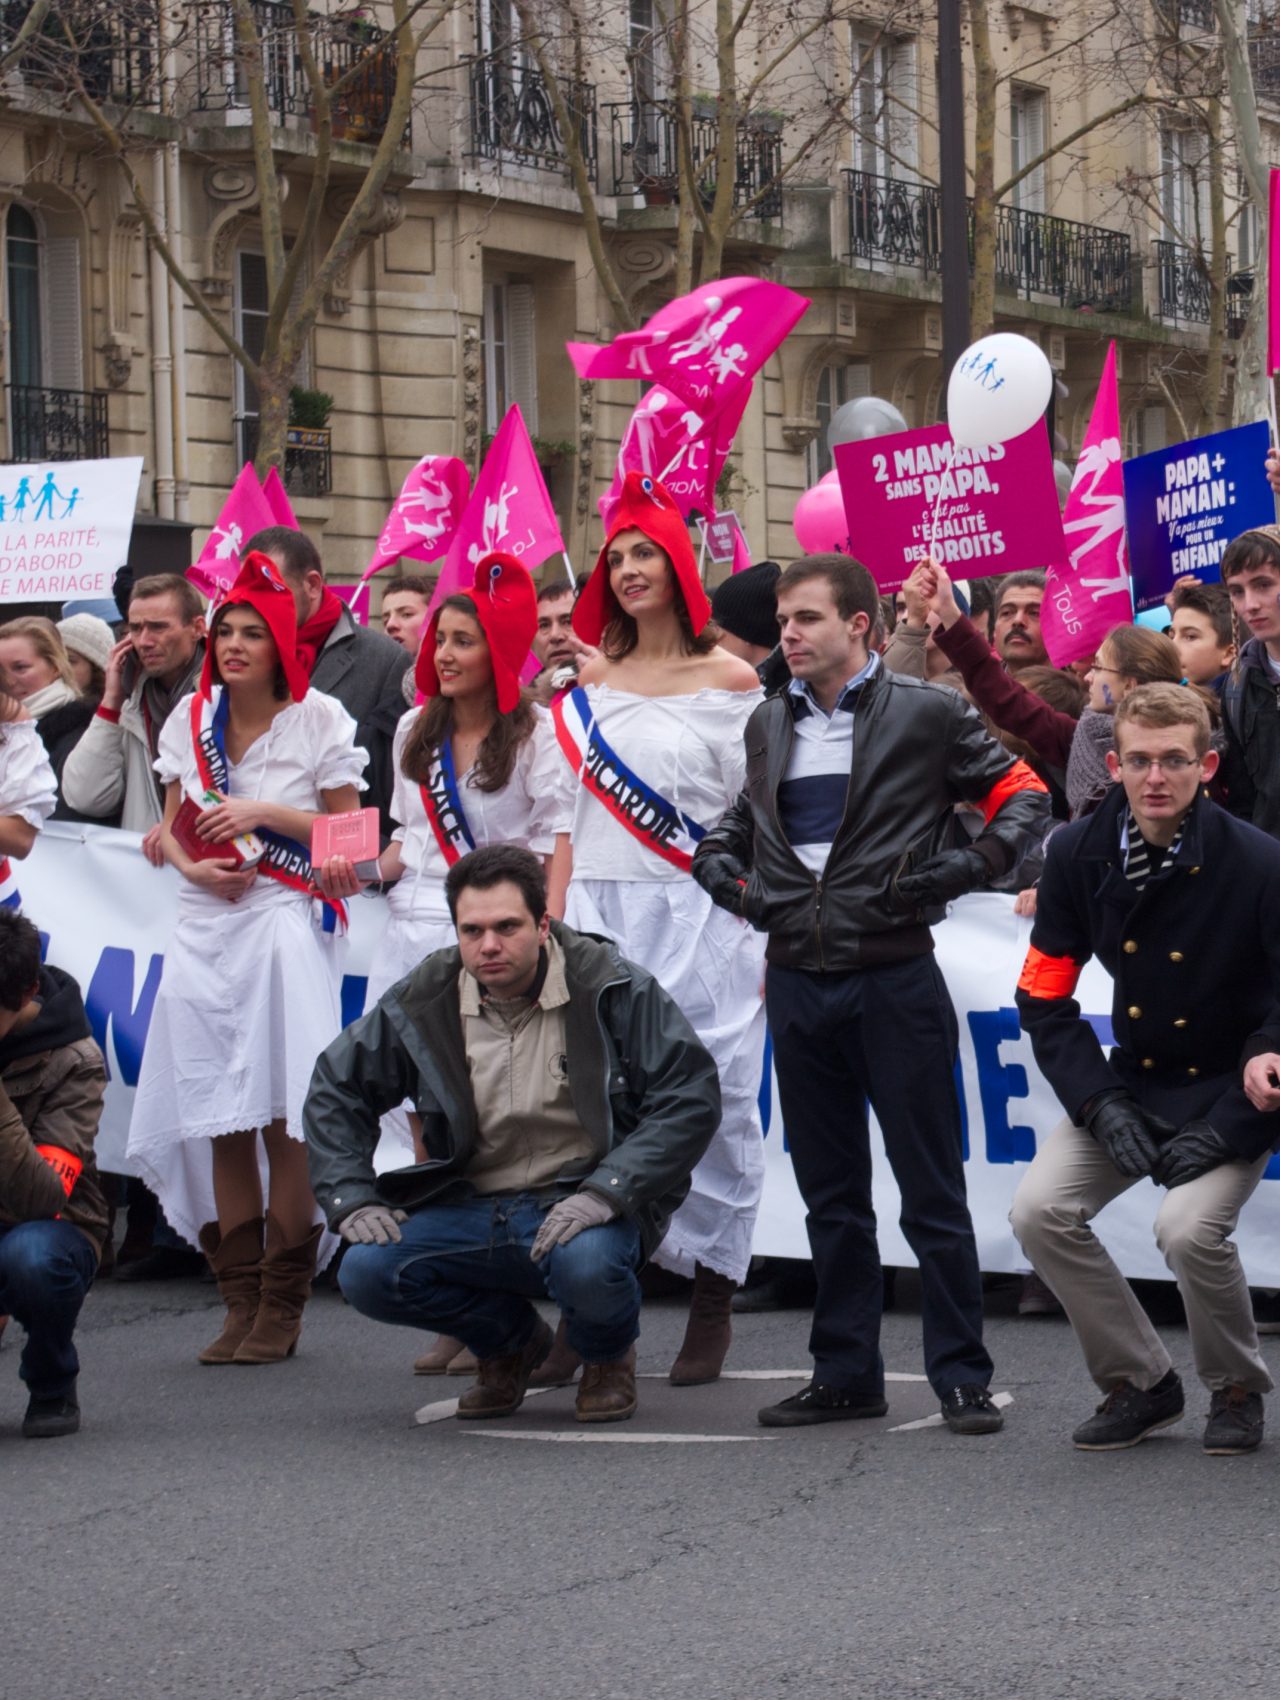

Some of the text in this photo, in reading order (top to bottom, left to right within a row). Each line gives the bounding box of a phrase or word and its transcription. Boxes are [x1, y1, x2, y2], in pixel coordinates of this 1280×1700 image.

[872, 441, 1006, 483] 2 MAMANS
[885, 465, 1000, 504] SANS PAPA,
[948, 502, 970, 520] pas
[5, 526, 101, 551] LA PARITÉ,
[1180, 520, 1196, 538] pas
[1196, 514, 1225, 530] mieux
[1185, 528, 1214, 546] POUR UN
[903, 531, 1006, 565] DES DROITS
[1171, 538, 1229, 575] ENFANT
[0, 552, 82, 574] D'ABORD
[16, 573, 104, 594] MARIAGE
[1052, 584, 1082, 635] Tous
[583, 740, 682, 851] PICARDIE
